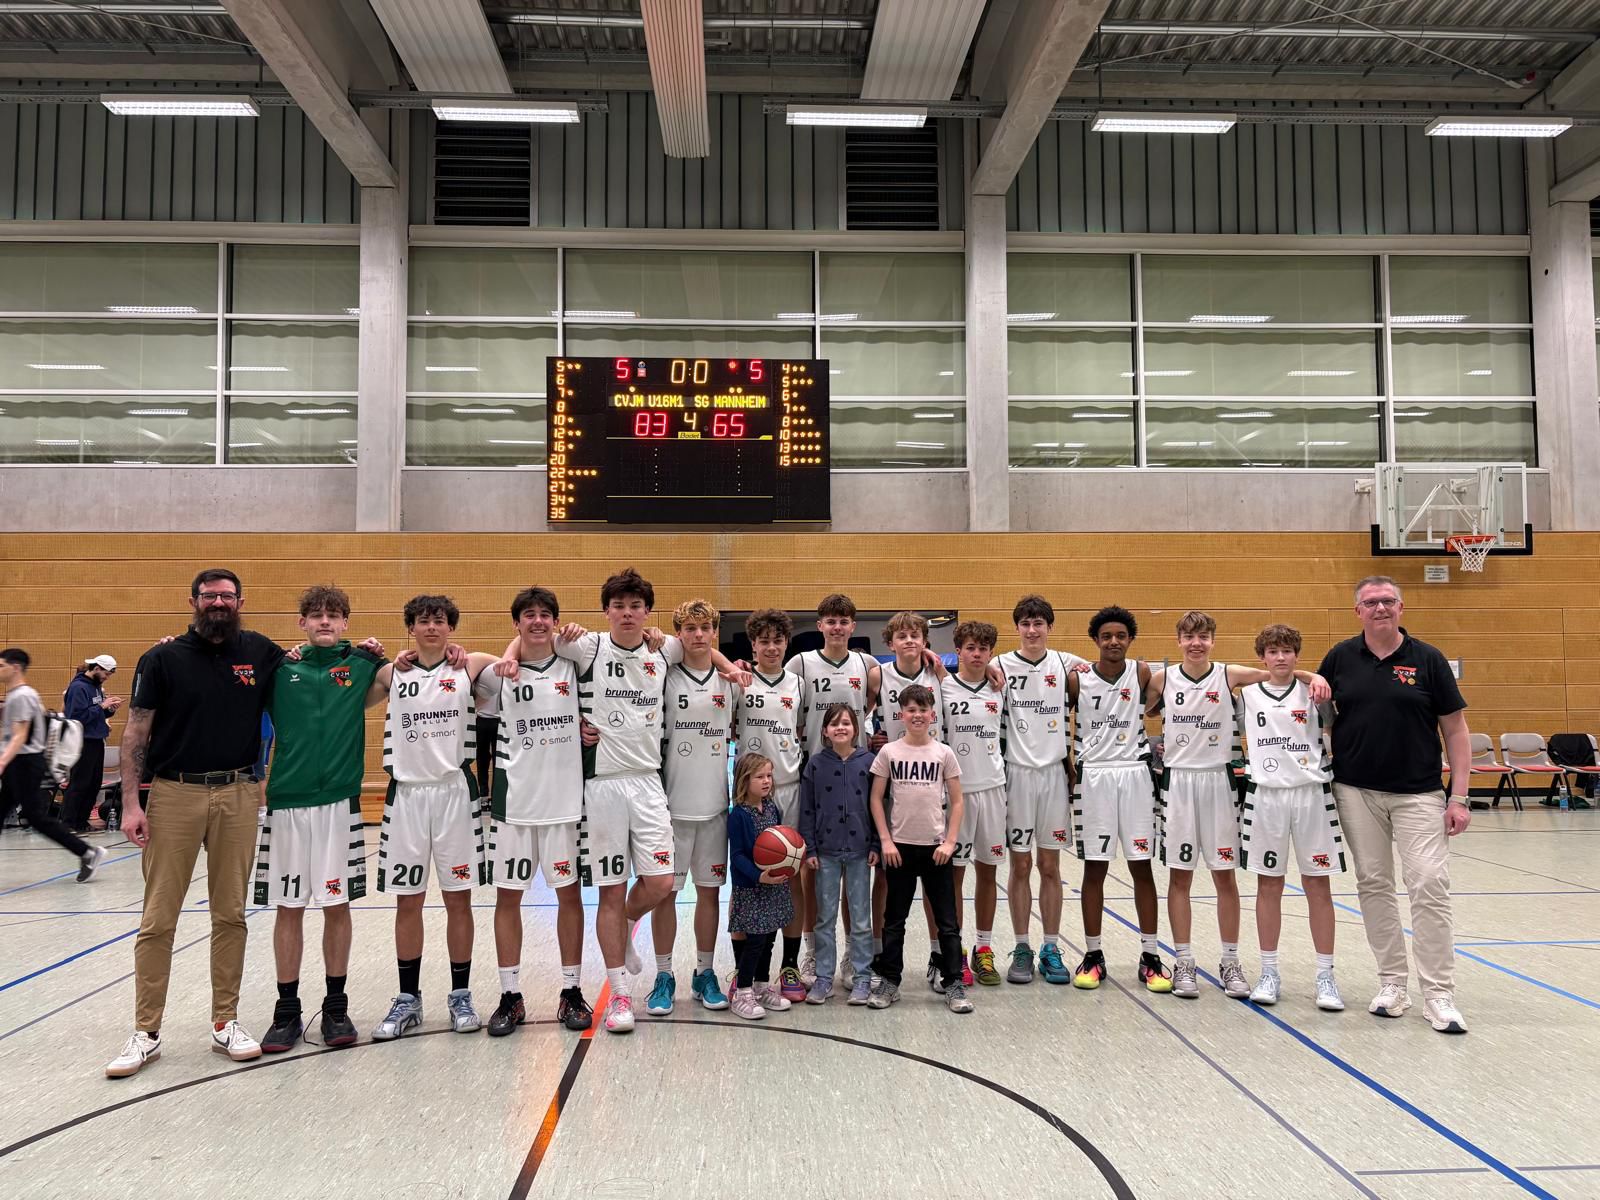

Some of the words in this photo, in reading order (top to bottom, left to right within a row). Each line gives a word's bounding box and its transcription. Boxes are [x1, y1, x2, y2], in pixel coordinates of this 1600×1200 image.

[556, 362, 565, 372] 5
[616, 360, 629, 379] 5
[750, 360, 762, 380] 5
[782, 364, 790, 372] 4
[556, 374, 565, 385] 6
[782, 377, 790, 388] 5
[558, 387, 565, 397] 7
[782, 390, 790, 400] 6
[556, 402, 565, 412] 8
[614, 394, 644, 408] CVJM
[648, 394, 684, 408] U16M1
[694, 395, 710, 408] SG
[714, 395, 766, 408] MANNHEIM
[782, 404, 790, 414] 7
[553, 414, 565, 425] 10
[635, 412, 667, 436] 83
[684, 412, 696, 430] 4
[713, 413, 744, 436] 65
[782, 416, 790, 427] 8
[553, 428, 565, 438] 12
[780, 430, 790, 440] 10
[553, 441, 565, 452] 16
[780, 442, 790, 453] 13
[550, 454, 565, 465] 20
[780, 456, 790, 466] 15
[550, 468, 565, 478] 22
[550, 481, 565, 492] 27
[550, 494, 565, 505] 34
[550, 508, 565, 518] 35
[606, 661, 625, 677] 16
[812, 678, 831, 692] 12
[1008, 676, 1027, 690] 27
[398, 682, 419, 698] 20
[512, 685, 534, 703] 10
[605, 688, 643, 697] brunner
[678, 694, 688, 710] 5
[746, 694, 764, 708] 35
[1011, 698, 1044, 706] brunner
[1092, 696, 1101, 710] 7
[1175, 692, 1184, 705] 8
[950, 701, 970, 715] 22
[413, 710, 459, 721] BRUNNER
[530, 715, 574, 727] BRUNNER
[746, 717, 778, 726] brunner
[1257, 711, 1266, 727] 6
[675, 720, 710, 728] brunner
[431, 729, 456, 738] smart
[549, 736, 572, 744] smart
[1258, 736, 1291, 745] brunner
[890, 761, 939, 781] MIAMI
[1012, 828, 1034, 845] 27
[953, 842, 972, 858] 22
[1099, 835, 1111, 853] 7
[1179, 843, 1192, 862] 8
[599, 855, 624, 876] 16
[1264, 851, 1277, 868] 6
[392, 864, 424, 886] 20
[505, 858, 532, 881] 10
[281, 874, 300, 898] 11
